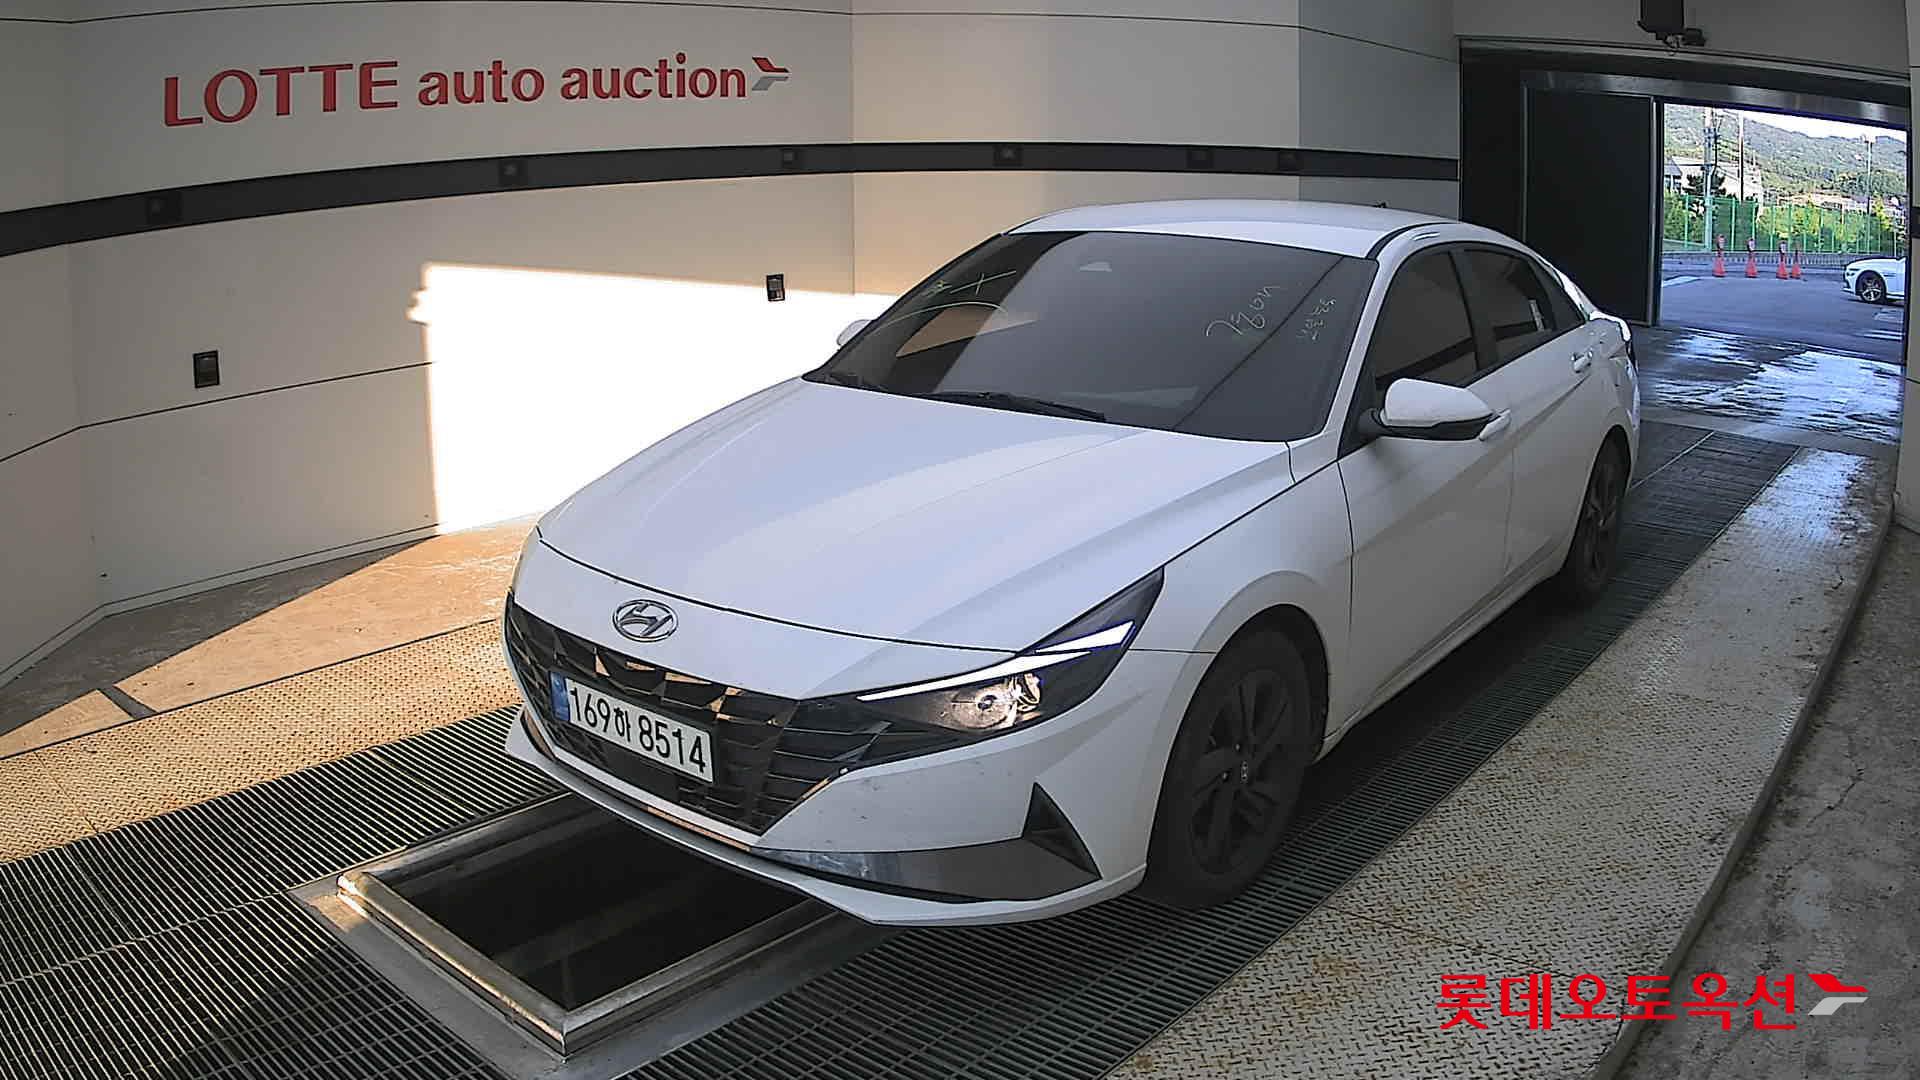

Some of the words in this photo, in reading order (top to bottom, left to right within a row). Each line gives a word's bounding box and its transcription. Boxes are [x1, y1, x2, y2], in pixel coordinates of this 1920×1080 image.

[164, 60, 399, 127] LOTTE
[417, 59, 545, 106] auto
[560, 52, 747, 101] auction
[569, 686, 631, 743] 169하
[638, 714, 706, 774] 8514
